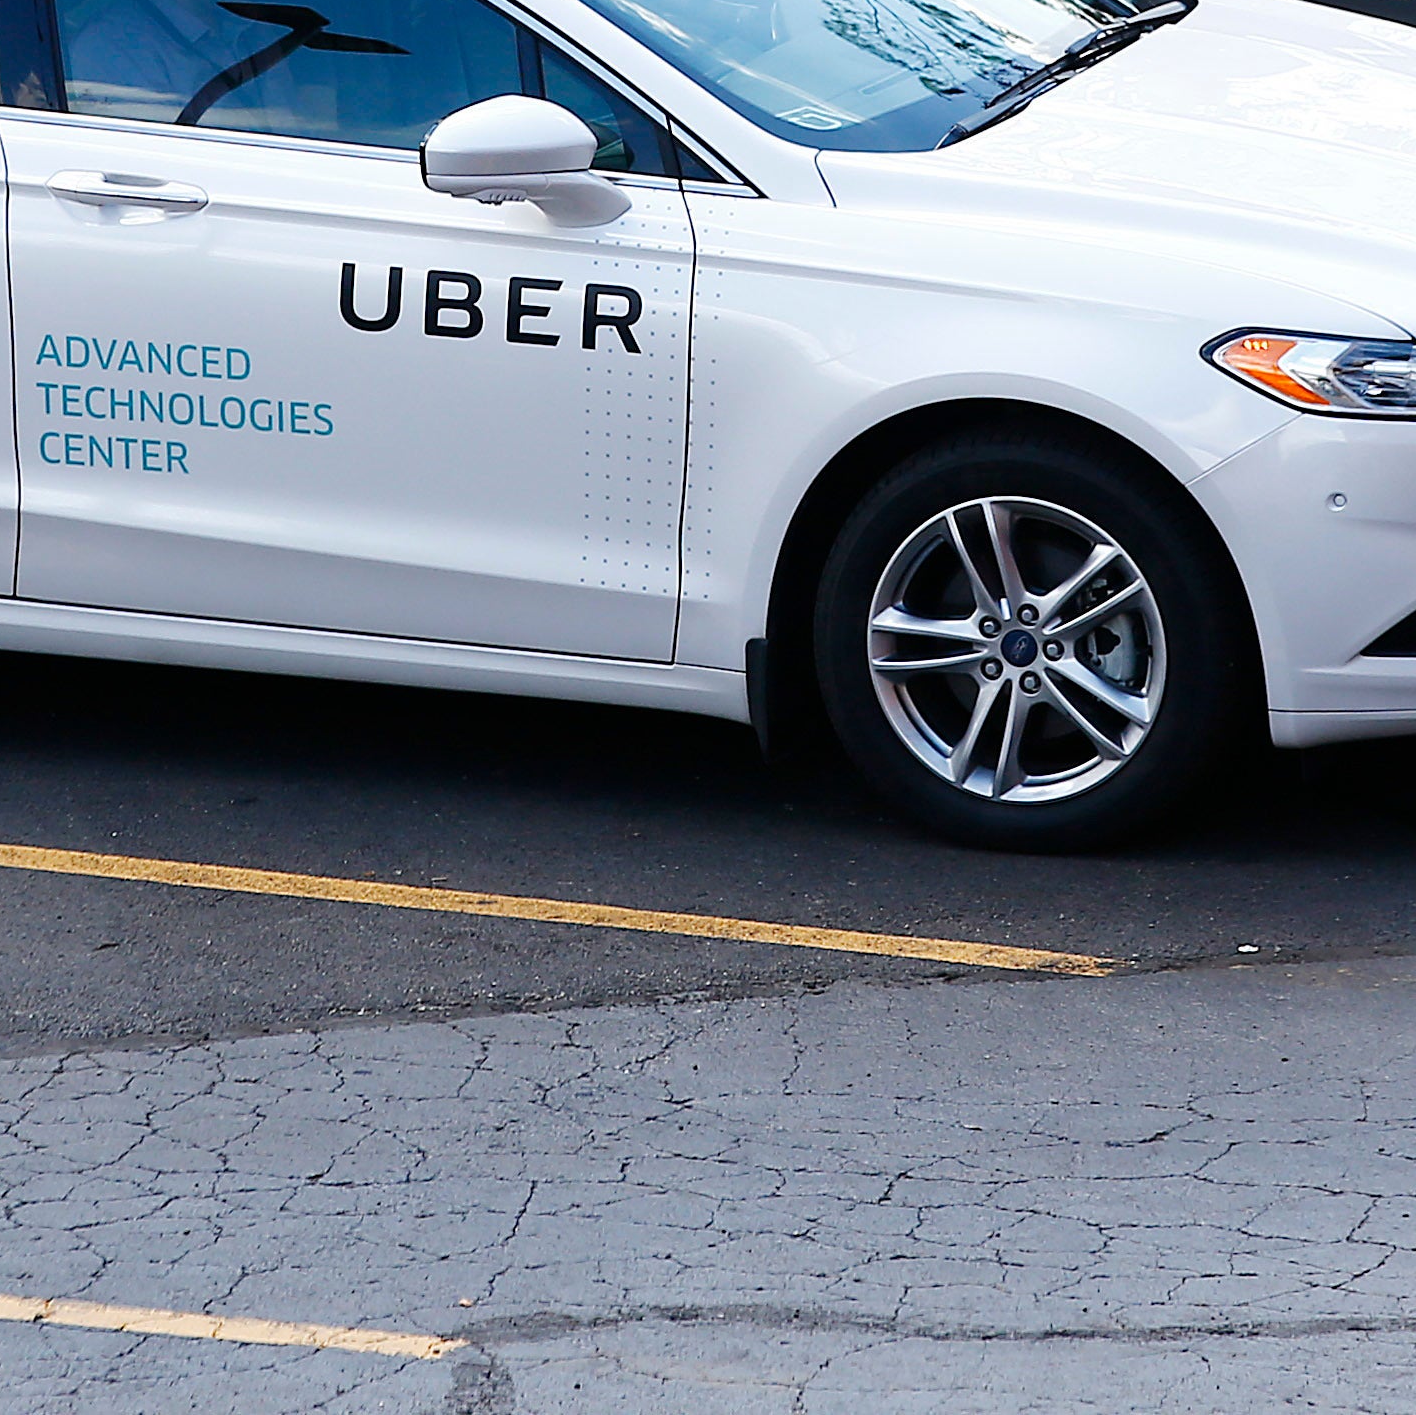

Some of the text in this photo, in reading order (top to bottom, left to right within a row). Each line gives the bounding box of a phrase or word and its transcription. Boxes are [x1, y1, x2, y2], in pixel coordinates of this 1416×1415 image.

[339, 261, 644, 355] UBER
[35, 333, 252, 382] ADVANCED
[35, 381, 335, 437] TECHNOLOGIES
[39, 430, 190, 474] CENTER
